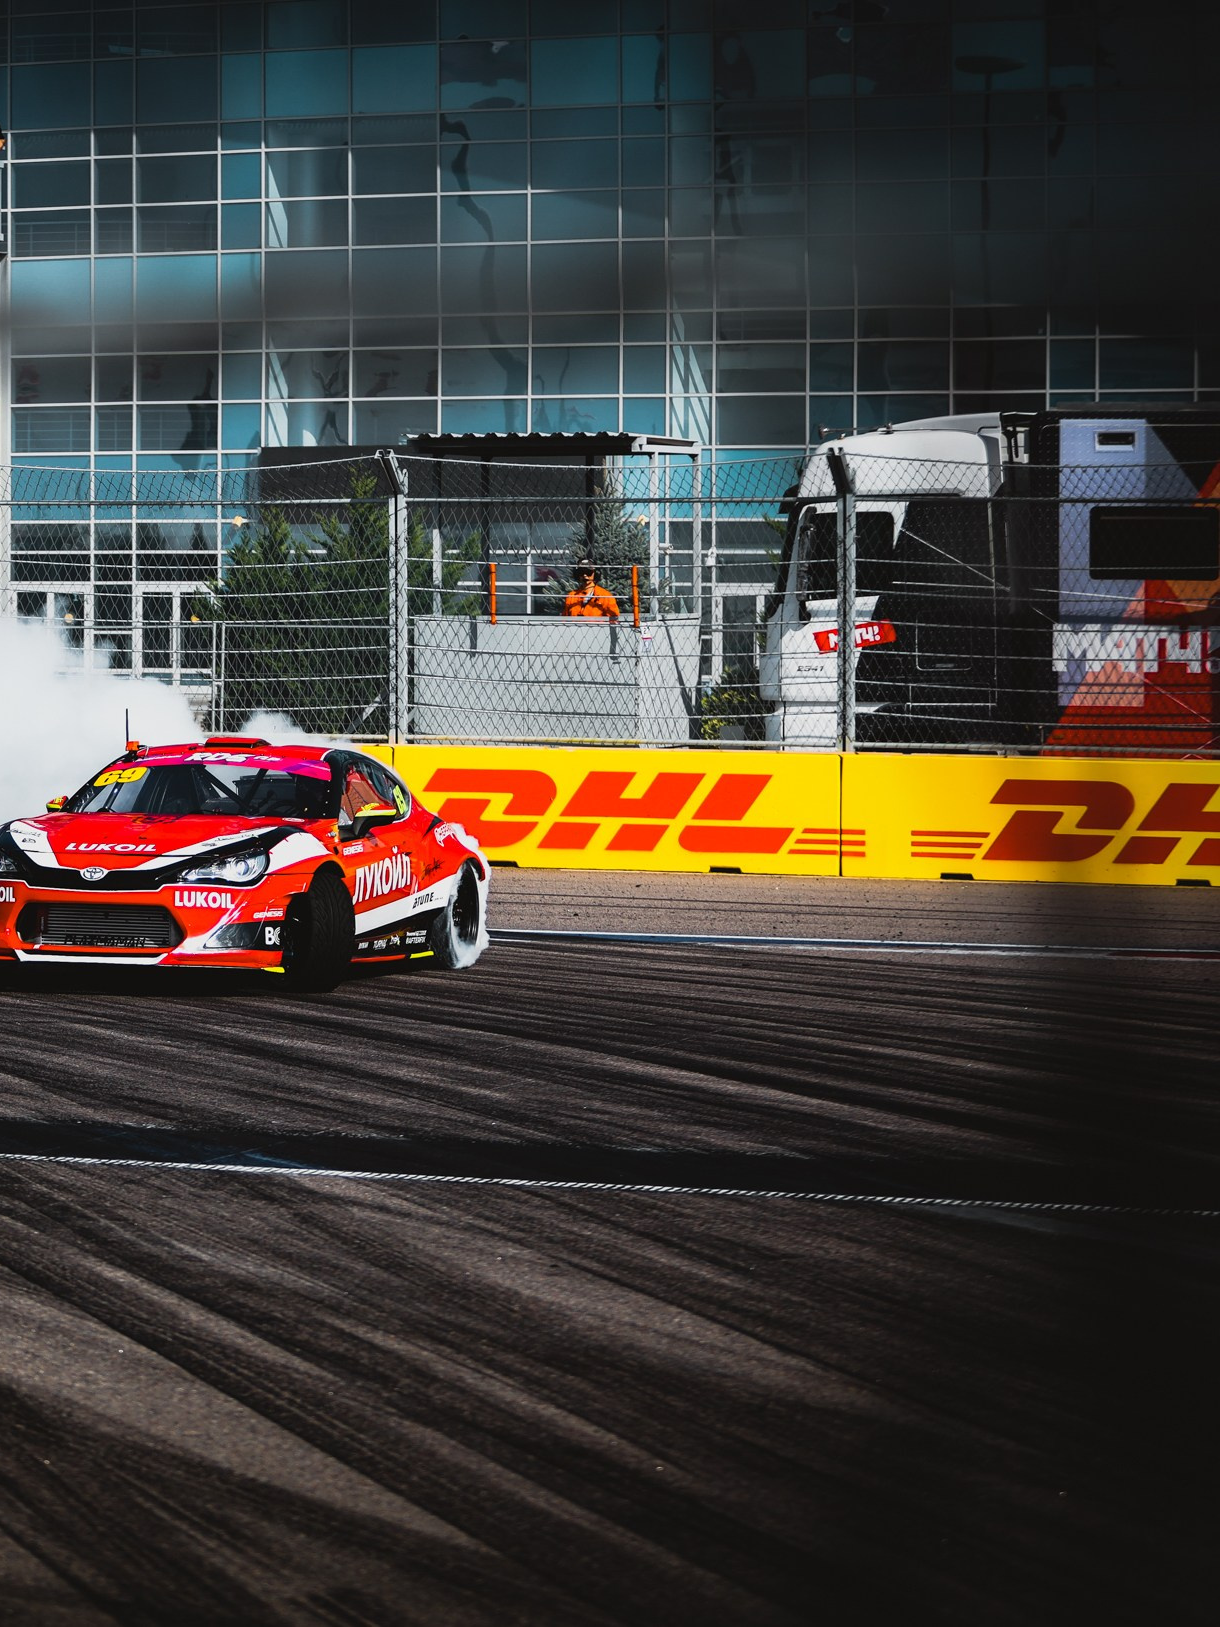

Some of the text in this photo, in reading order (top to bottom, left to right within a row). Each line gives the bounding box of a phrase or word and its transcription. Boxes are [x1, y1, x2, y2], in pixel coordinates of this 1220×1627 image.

[93, 766, 148, 787] 69
[423, 768, 794, 855] DHL
[982, 779, 1220, 865] DH
[65, 842, 156, 852] LUKOIL
[352, 845, 411, 906] ЛУКОЙЛ
[174, 891, 235, 909] LUKOIL
